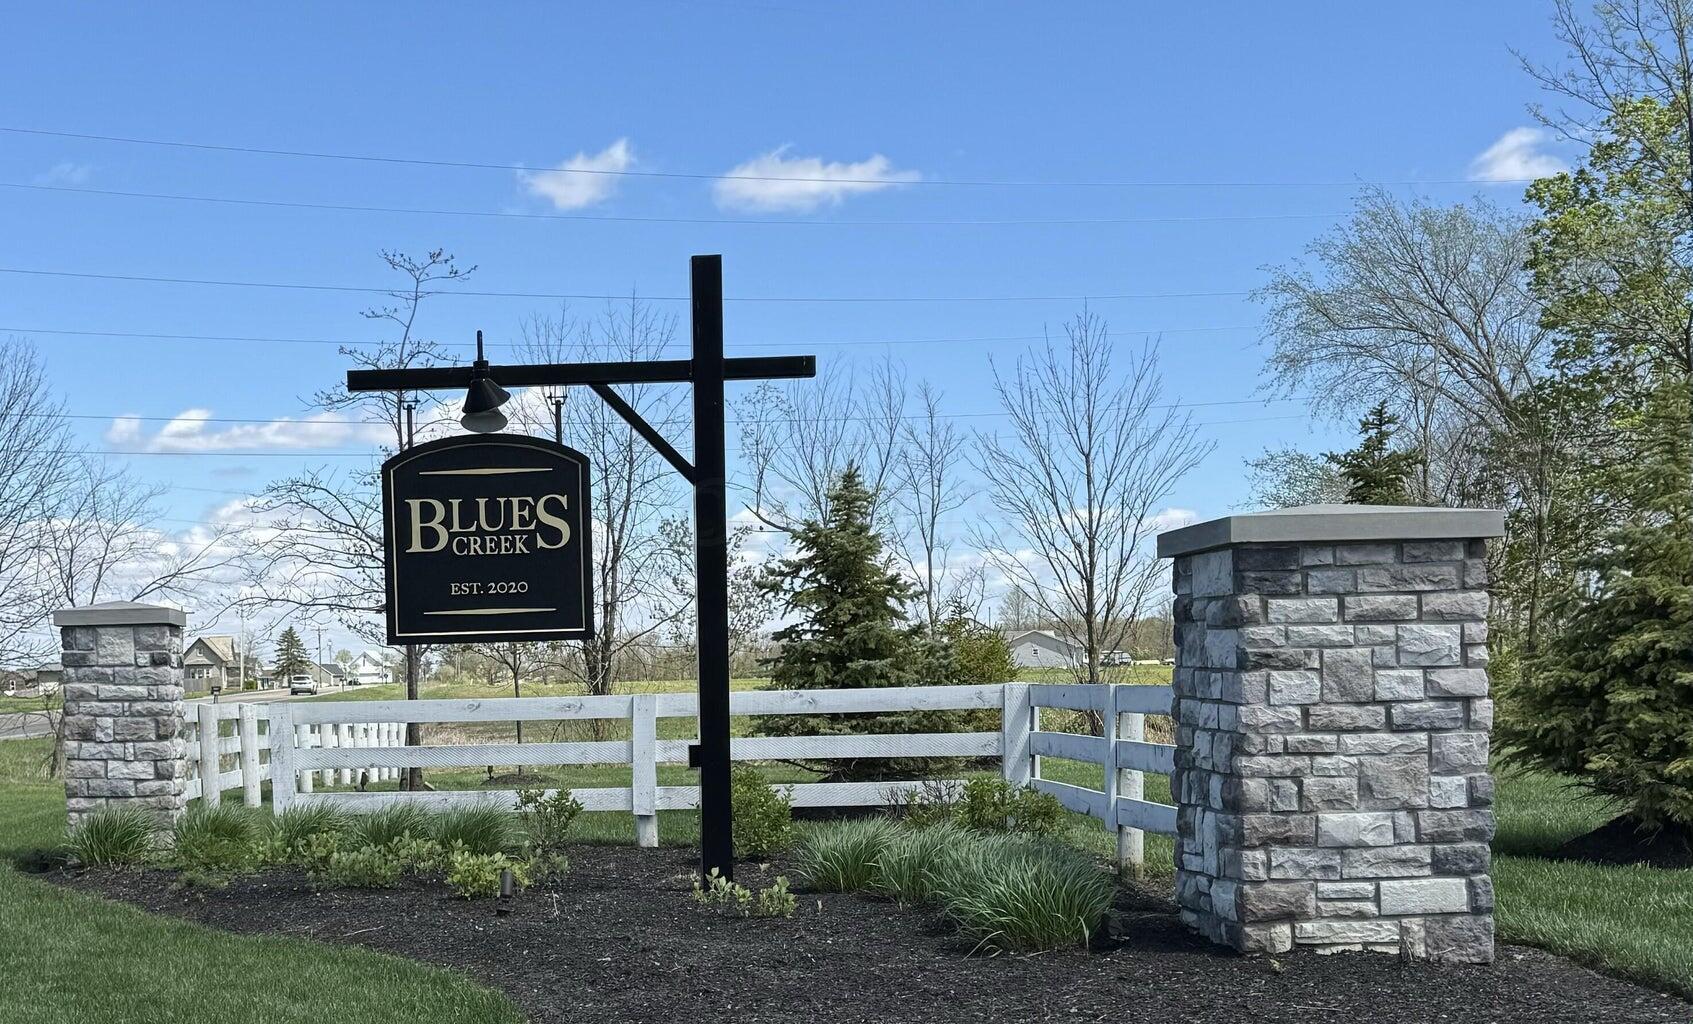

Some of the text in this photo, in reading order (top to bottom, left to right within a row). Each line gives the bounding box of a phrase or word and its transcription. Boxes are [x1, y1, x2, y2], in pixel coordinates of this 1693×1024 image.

[405, 494, 571, 553] BLUES
[452, 535, 531, 555] CREEK
[450, 581, 528, 595] EST. 2020
